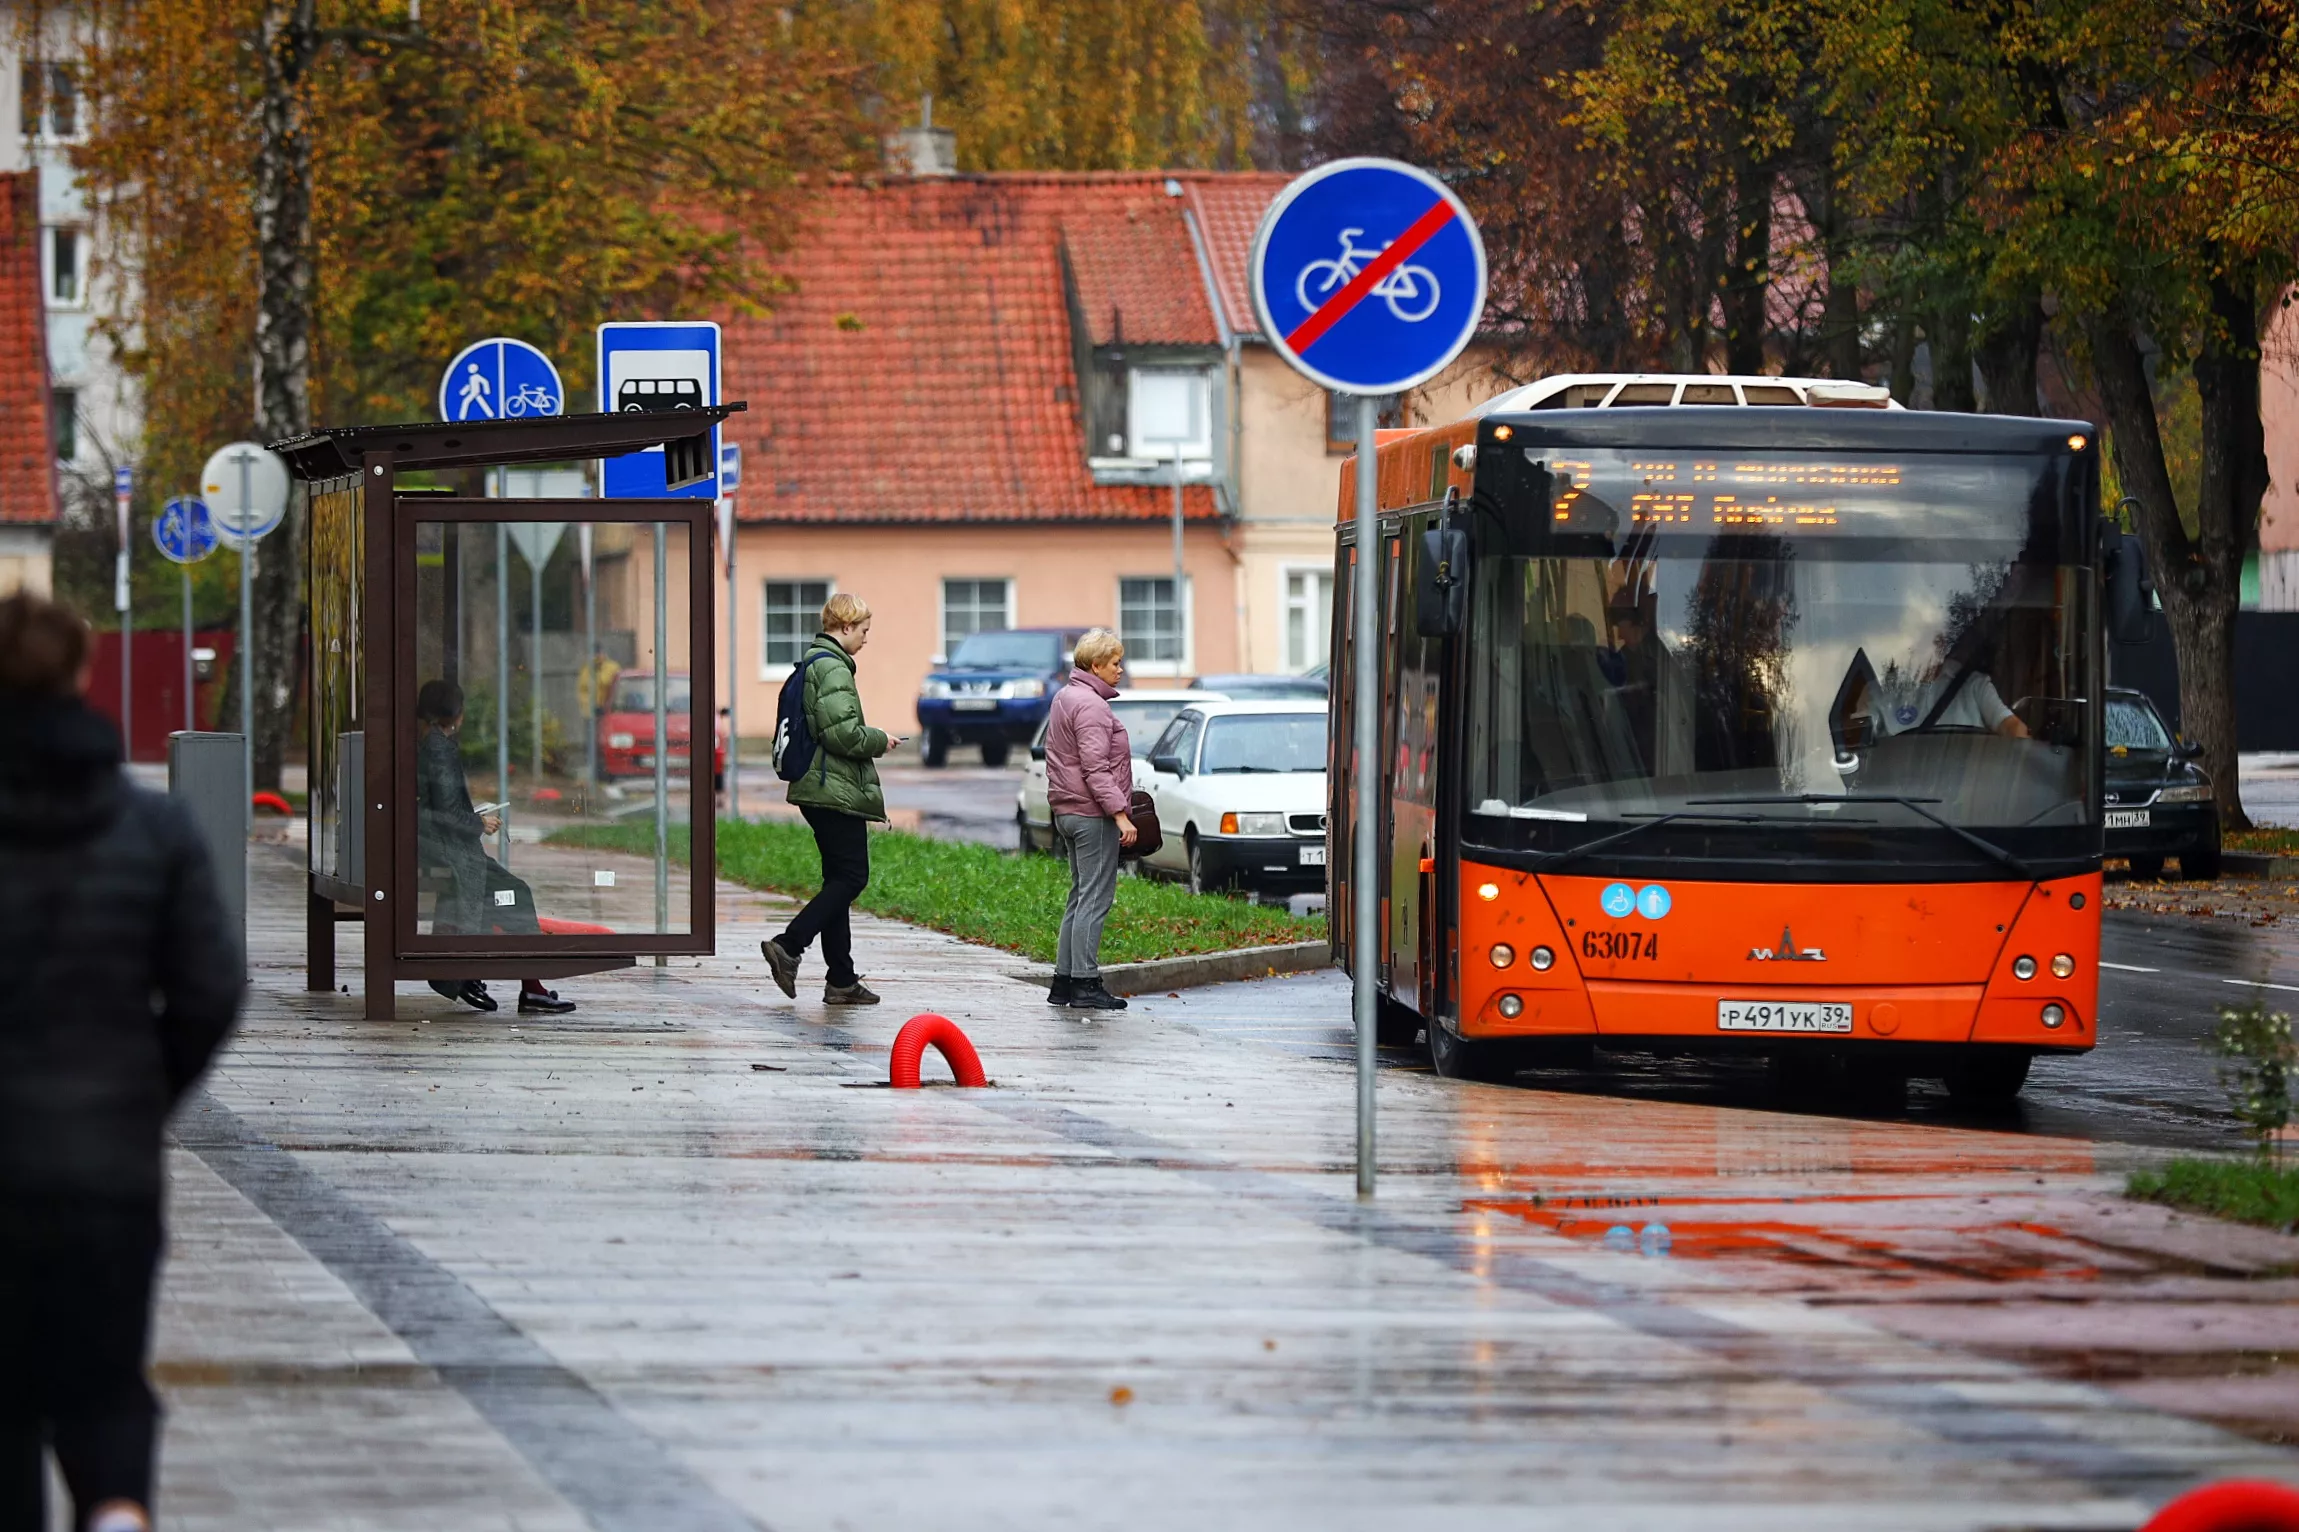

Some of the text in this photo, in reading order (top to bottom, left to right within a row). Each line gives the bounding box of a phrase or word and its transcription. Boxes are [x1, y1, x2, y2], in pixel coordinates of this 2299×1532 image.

[1583, 931, 1657, 960] 63074
[1728, 1006, 1844, 1028] Р491УК 39
[1821, 1021, 1838, 1029] RUS
